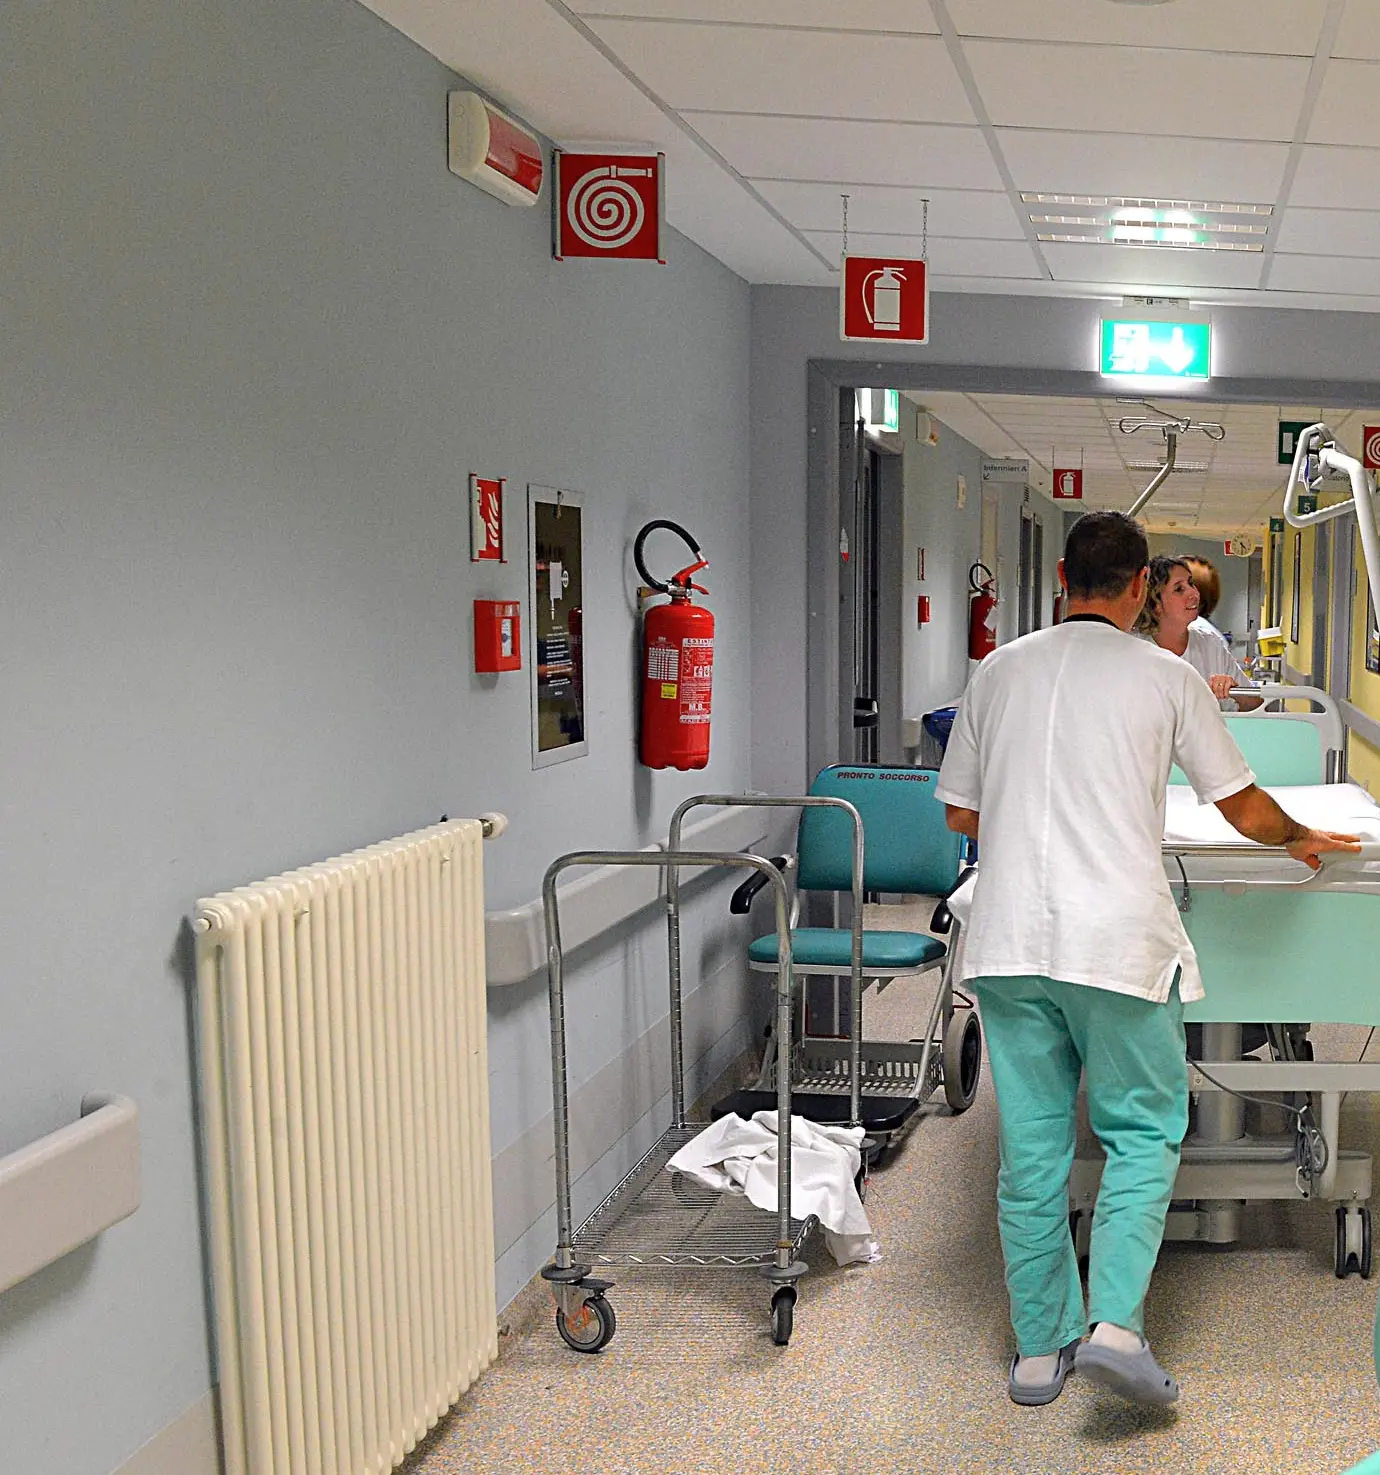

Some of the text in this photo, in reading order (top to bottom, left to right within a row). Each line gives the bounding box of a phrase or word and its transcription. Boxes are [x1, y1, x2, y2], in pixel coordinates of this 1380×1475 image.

[1303, 502, 1311, 513] 5
[837, 771, 930, 782] PRONTO SOCCORSO
